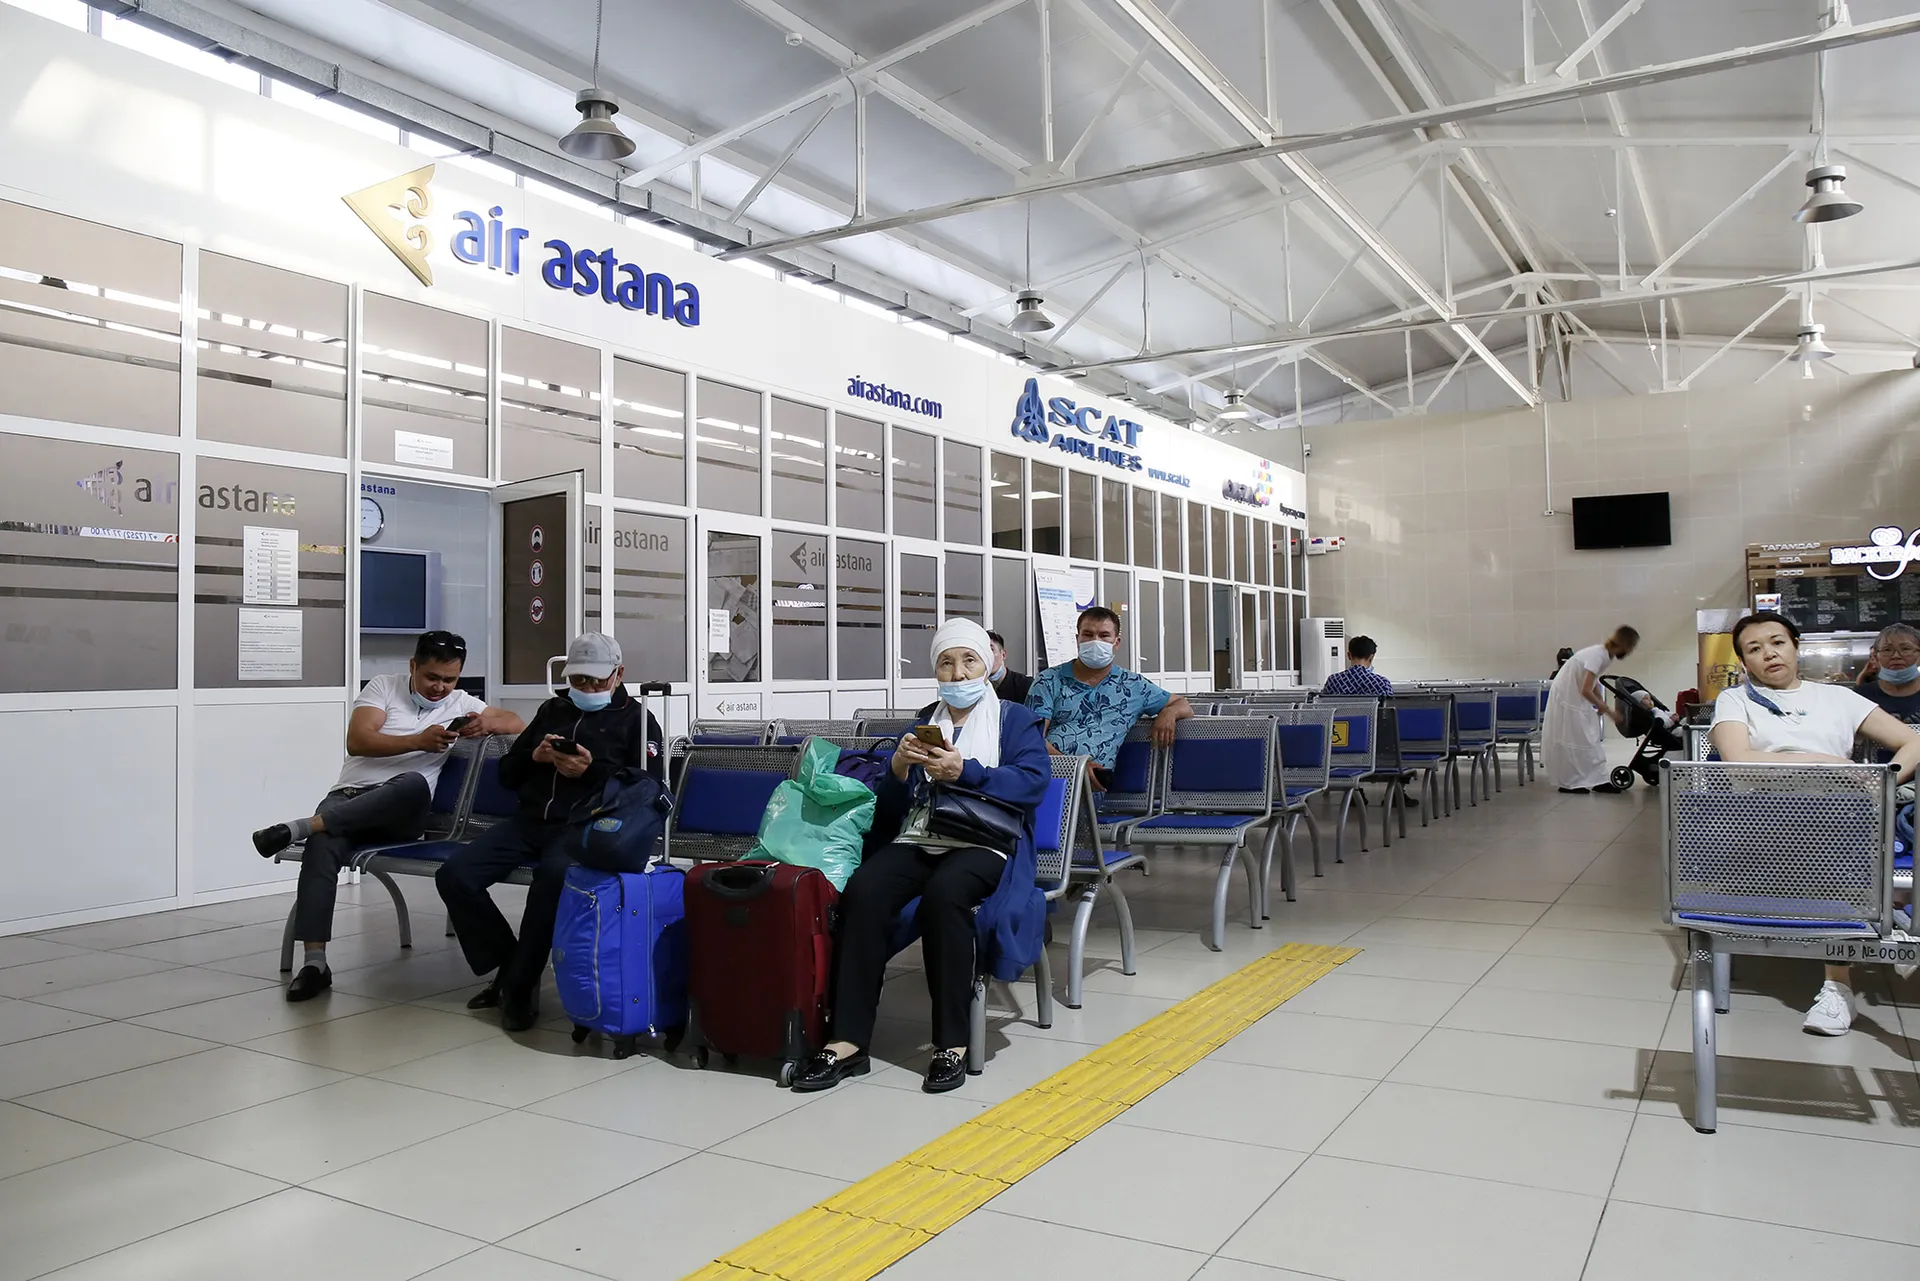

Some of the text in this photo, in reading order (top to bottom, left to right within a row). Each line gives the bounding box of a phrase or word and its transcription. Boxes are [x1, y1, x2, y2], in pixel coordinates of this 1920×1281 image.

[450, 205, 700, 327] air astana
[847, 375, 942, 419] airastana.com
[1048, 396, 1143, 449] SCAT
[1049, 433, 1143, 471] AIRLINES
[134, 474, 295, 516] air astana
[361, 483, 396, 495] astana
[614, 529, 669, 552] astana
